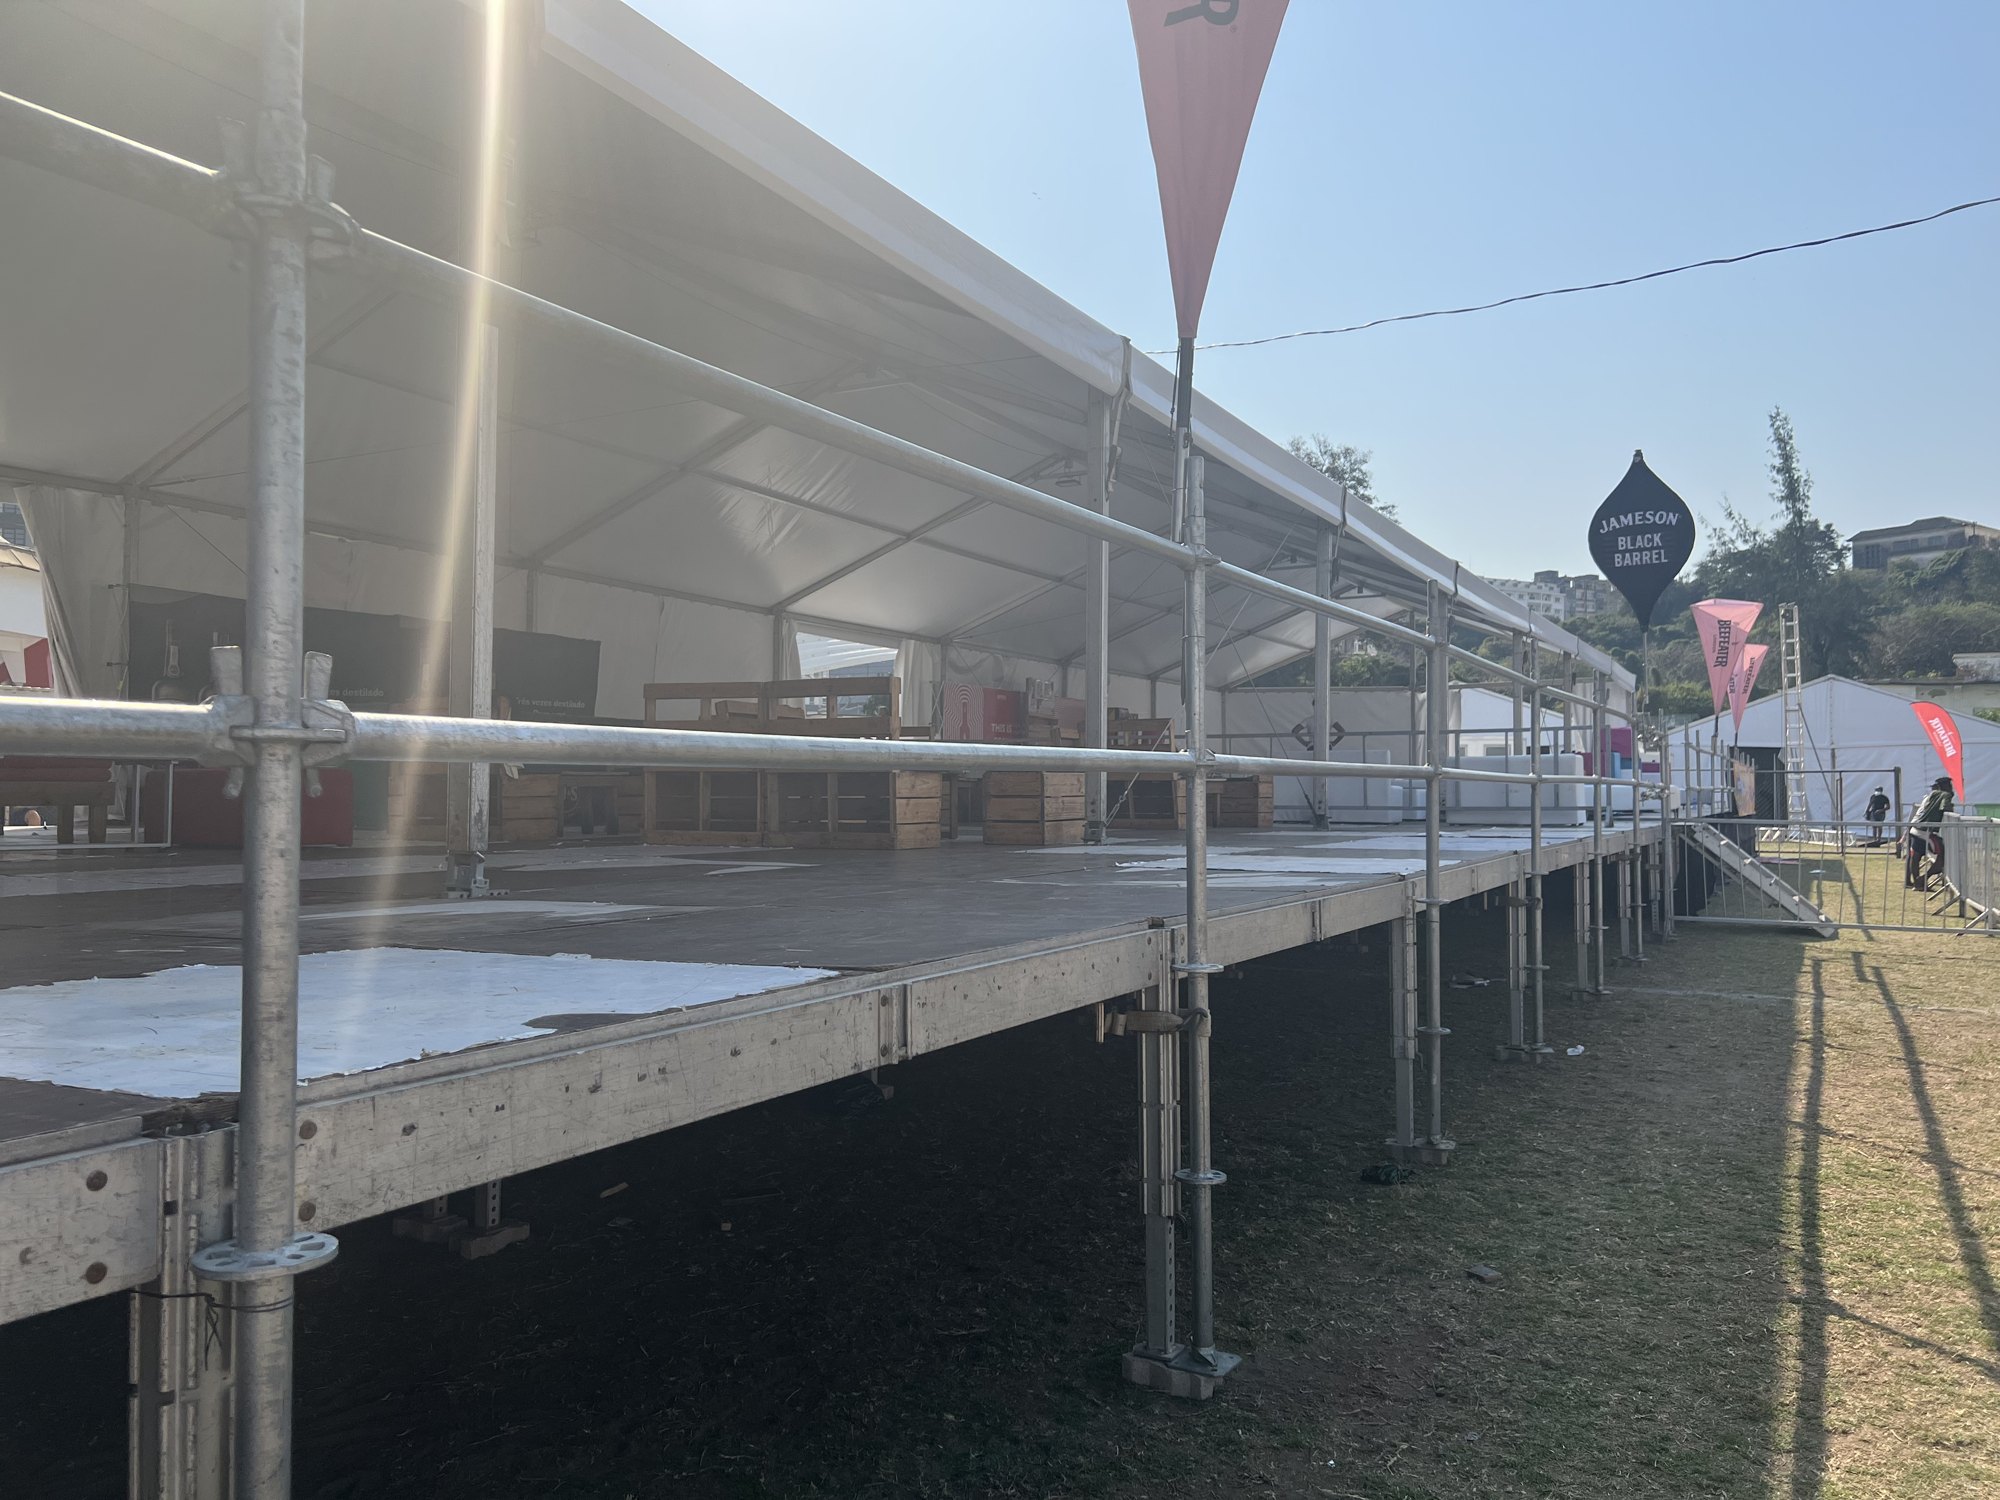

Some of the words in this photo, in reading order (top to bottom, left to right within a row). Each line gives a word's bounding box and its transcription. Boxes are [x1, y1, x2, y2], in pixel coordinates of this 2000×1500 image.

[1599, 510, 1679, 534] JAMESON
[1618, 533, 1662, 550] BLACK
[1614, 549, 1668, 567] BARREL
[1713, 619, 1731, 668] BEEFEATER
[991, 723, 1006, 733] THIS
[1006, 724, 1013, 734] IS
